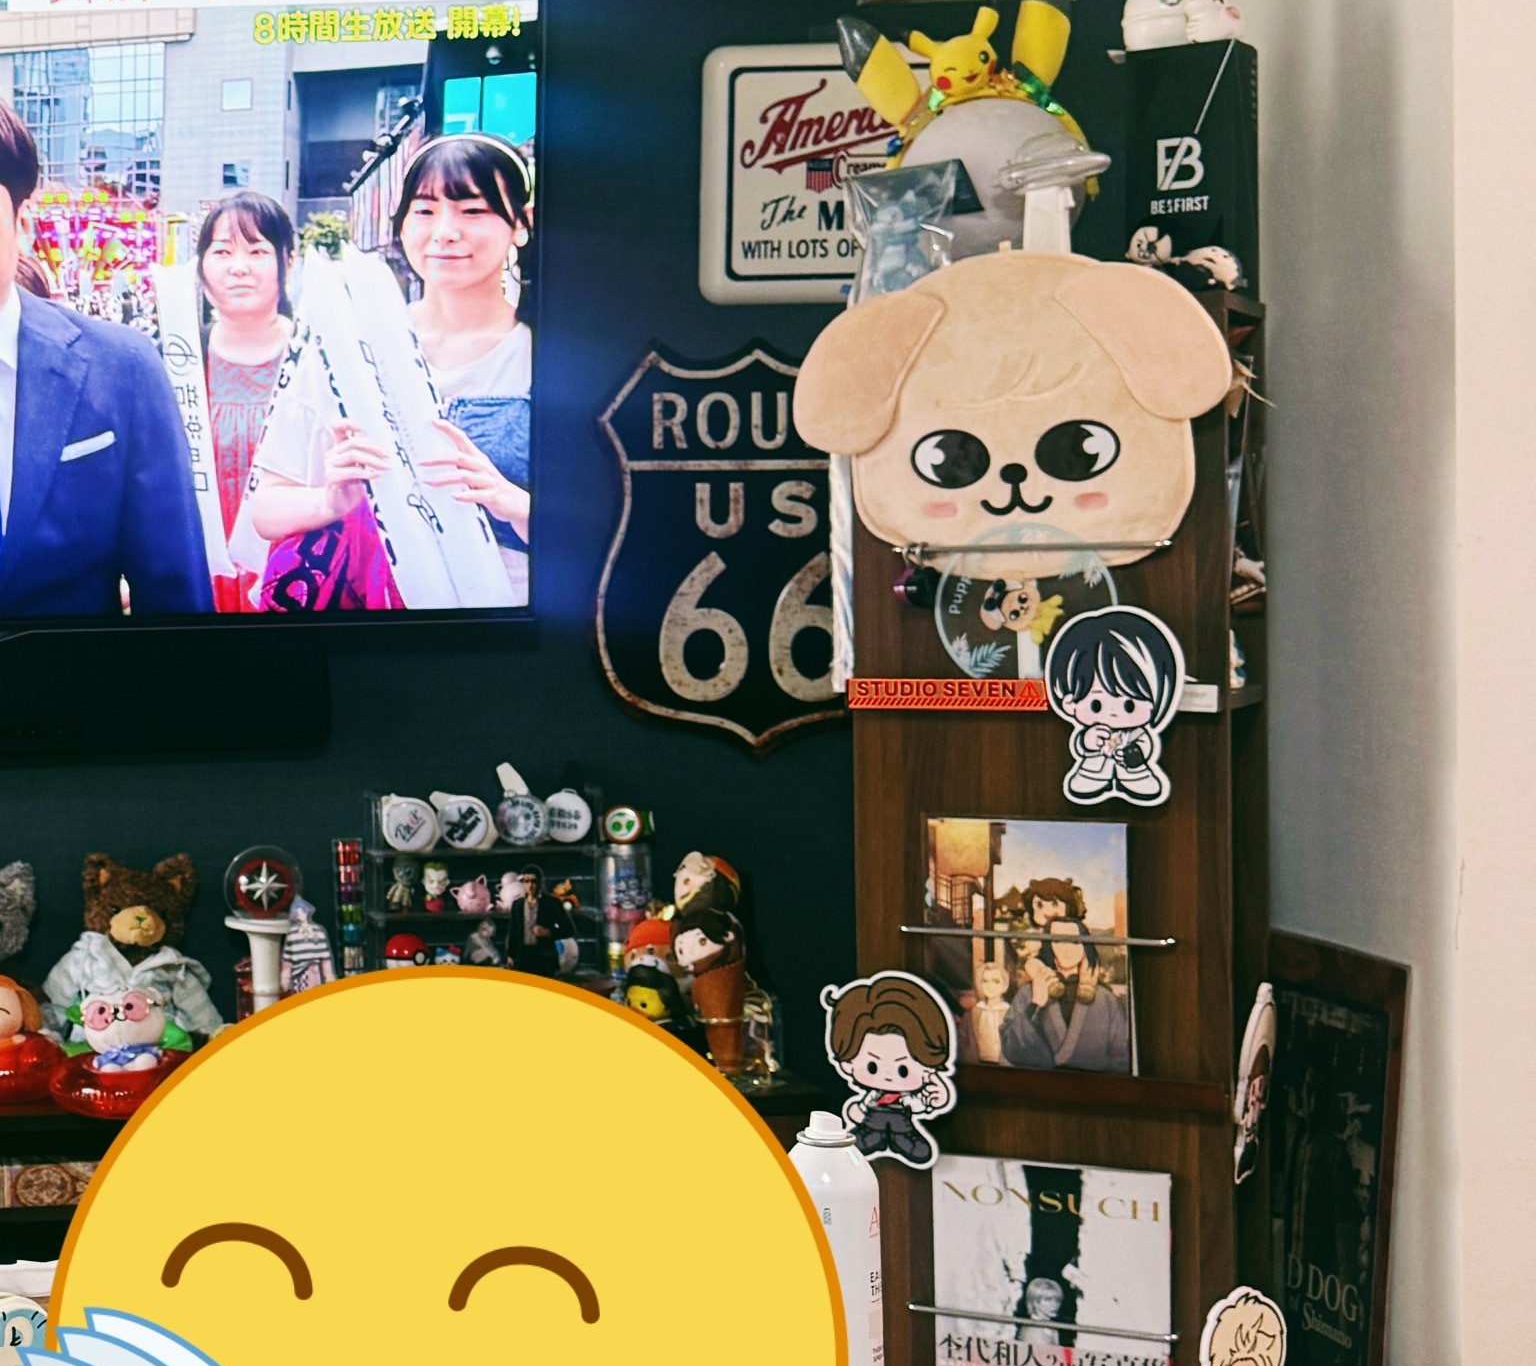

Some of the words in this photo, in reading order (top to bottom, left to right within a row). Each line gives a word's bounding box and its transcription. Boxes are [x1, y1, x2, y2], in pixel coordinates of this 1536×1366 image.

[253, 9, 438, 45] 8時間生放送
[760, 195, 807, 231] The
[741, 240, 781, 260] WITH
[787, 239, 829, 259] LOTS
[651, 390, 789, 451] ROU
[658, 550, 834, 703] 66
[856, 680, 937, 698] STUDIO
[943, 681, 1016, 698] SEVEN
[1307, 1263, 1358, 1322] DOG
